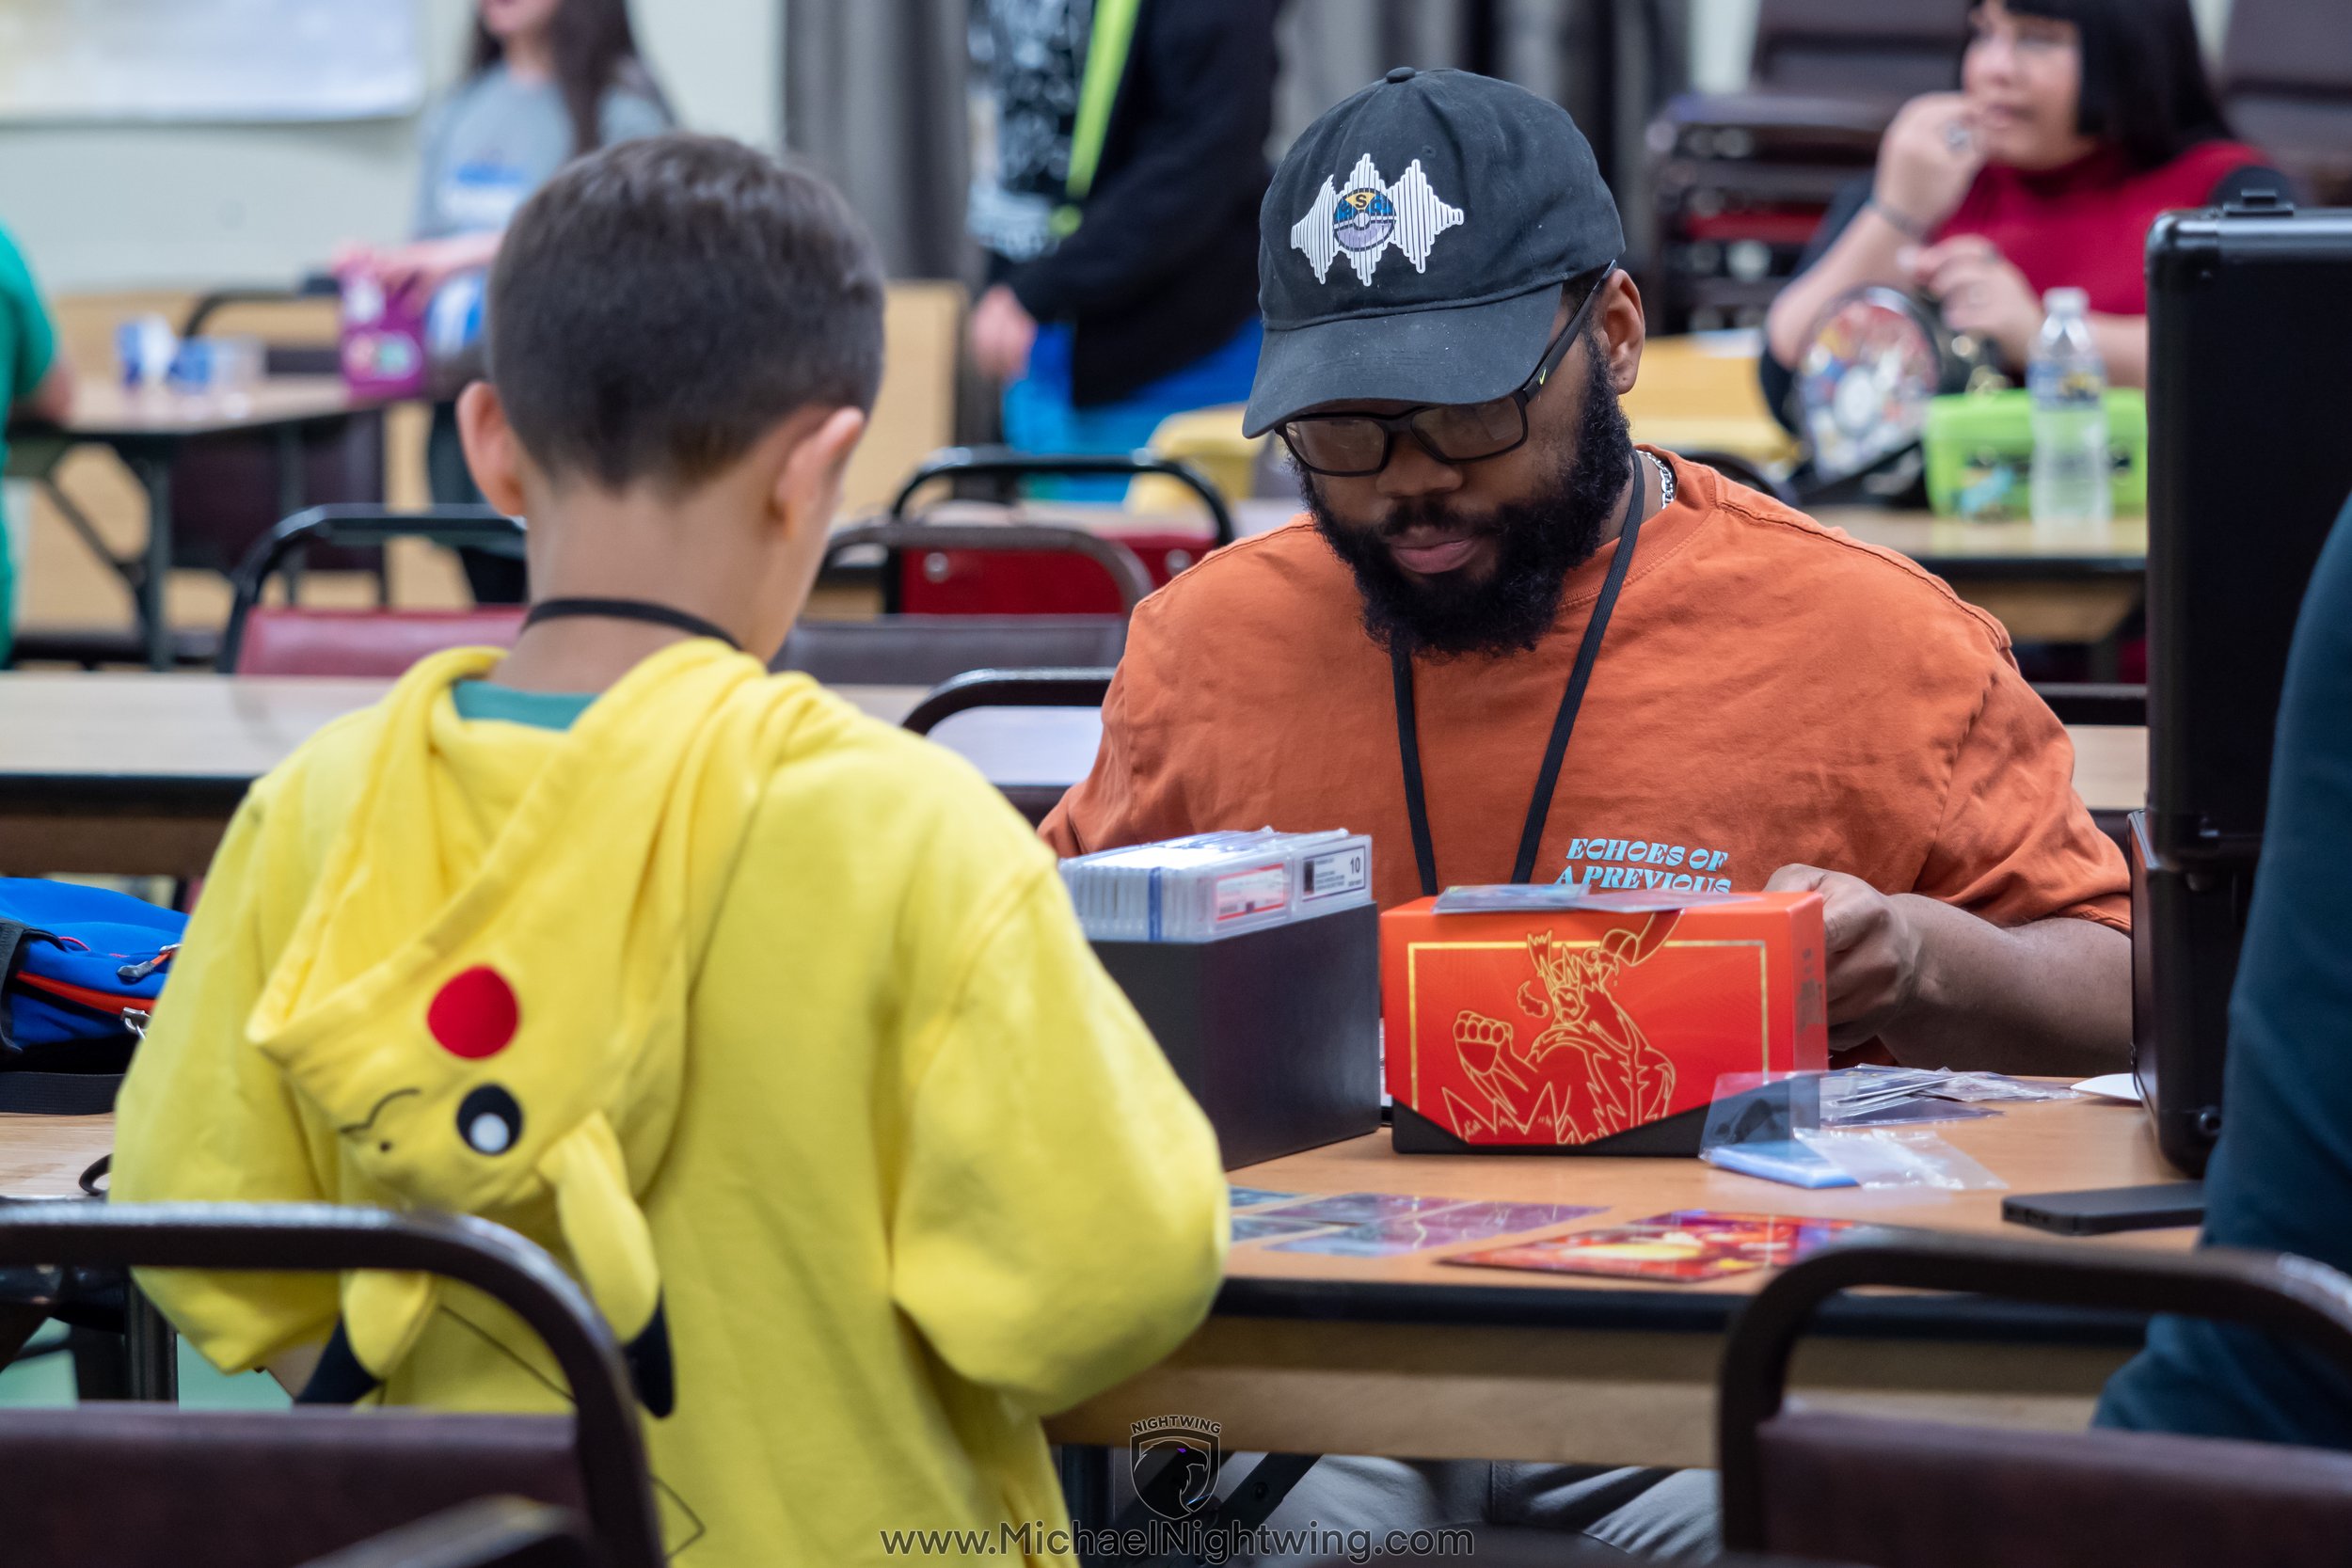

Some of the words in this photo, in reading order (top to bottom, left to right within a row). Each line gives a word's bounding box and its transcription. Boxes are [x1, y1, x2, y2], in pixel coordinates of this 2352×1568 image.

[1350, 856, 1360, 875] 10
[1565, 838, 1686, 867] ECHOES
[1689, 848, 1728, 872] OF
[1554, 865, 1574, 885] A
[1581, 865, 1732, 894] PREVIOUS
